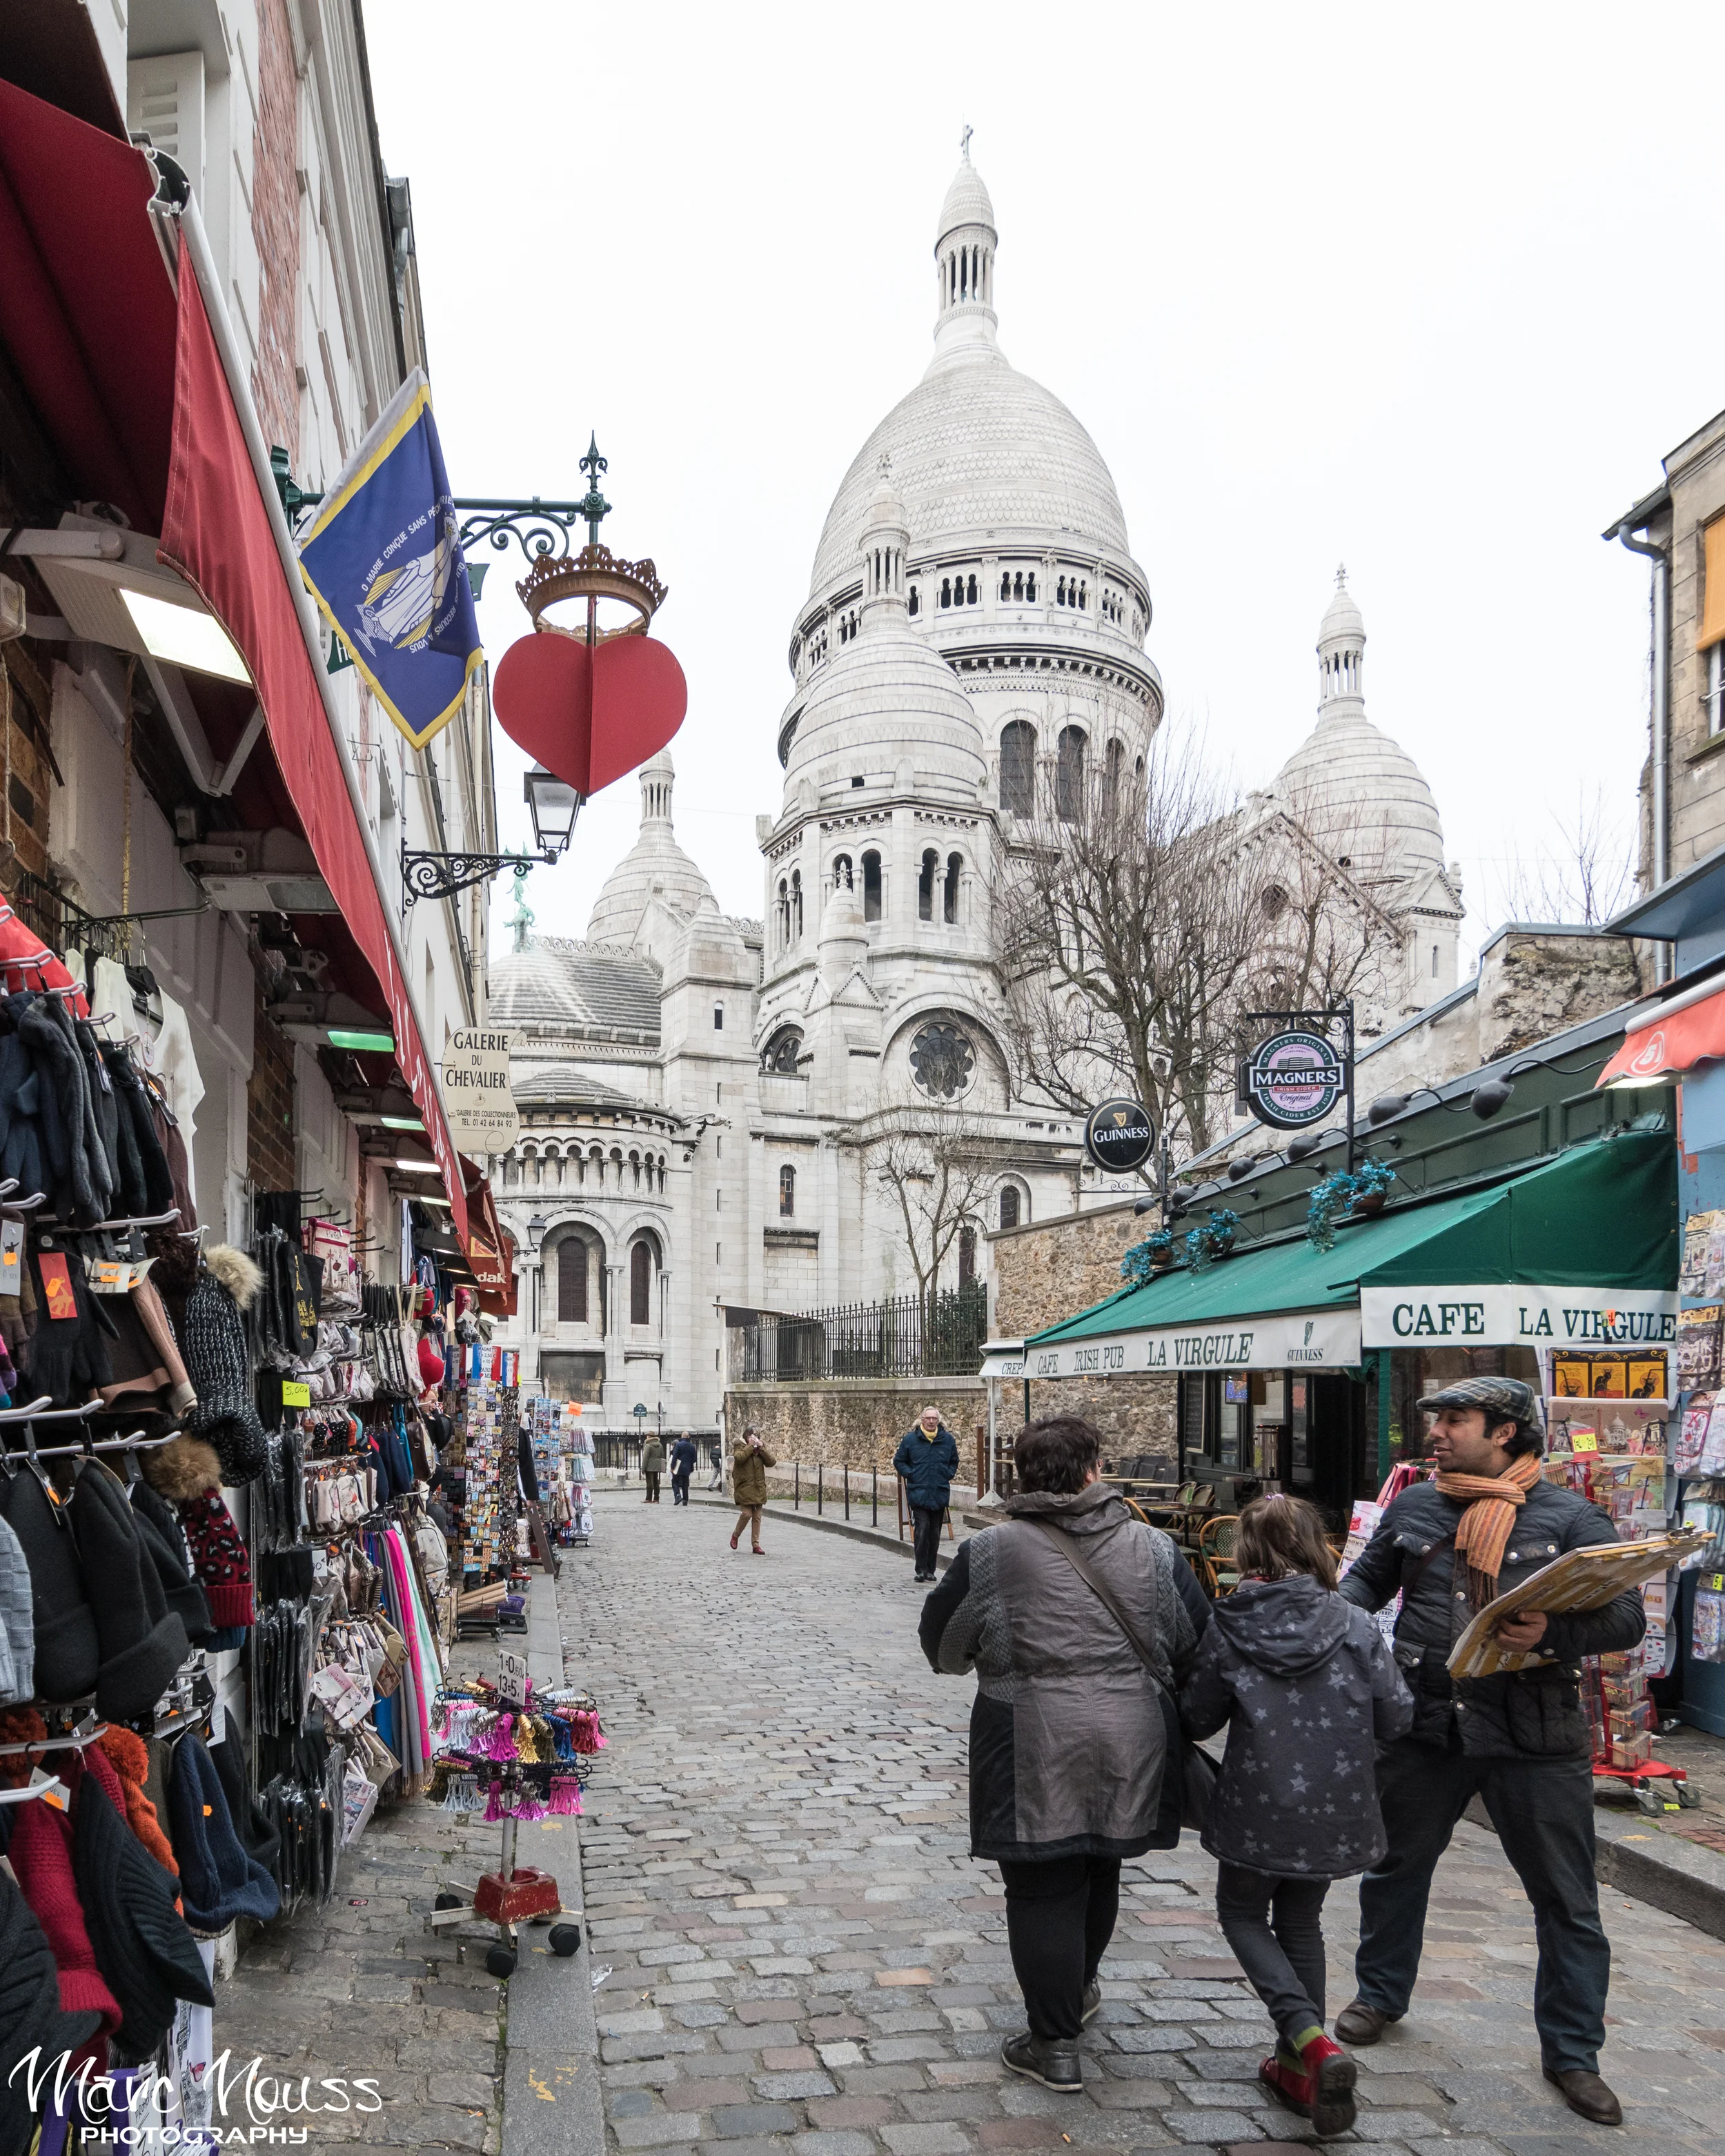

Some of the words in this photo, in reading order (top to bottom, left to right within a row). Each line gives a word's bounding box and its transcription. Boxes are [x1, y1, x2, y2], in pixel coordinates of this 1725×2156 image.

[366, 557, 384, 583] MARIE
[383, 531, 408, 559] CONÇUE
[408, 515, 427, 535] SANS
[435, 604, 457, 637] RECOURS
[409, 638, 428, 654] VOUS
[453, 1032, 509, 1051] GALERIE
[1263, 1037, 1294, 1063] MAGNERS
[1297, 1037, 1330, 1062] ORIGINAL
[471, 1054, 482, 1066] DU
[446, 1069, 506, 1089] CHEVALIER
[1255, 1069, 1338, 1086] MAGNERS
[1263, 1093, 1279, 1112] IRISH
[1323, 1091, 1332, 1105] 1935
[1279, 1093, 1313, 1105] Original
[461, 1118, 471, 1126] TEL.
[473, 1118, 478, 1127] 01
[1094, 1127, 1149, 1143] GUINNESS
[1392, 1303, 1485, 1337] CAFE
[1519, 1307, 1554, 1337] LA
[1147, 1340, 1167, 1367] LA
[1174, 1332, 1254, 1366] VIRGULE
[1287, 1347, 1323, 1362] GUINNESS
[1037, 1353, 1059, 1375] CAFE
[1073, 1347, 1100, 1372] IRISH
[1103, 1345, 1125, 1369] PUB
